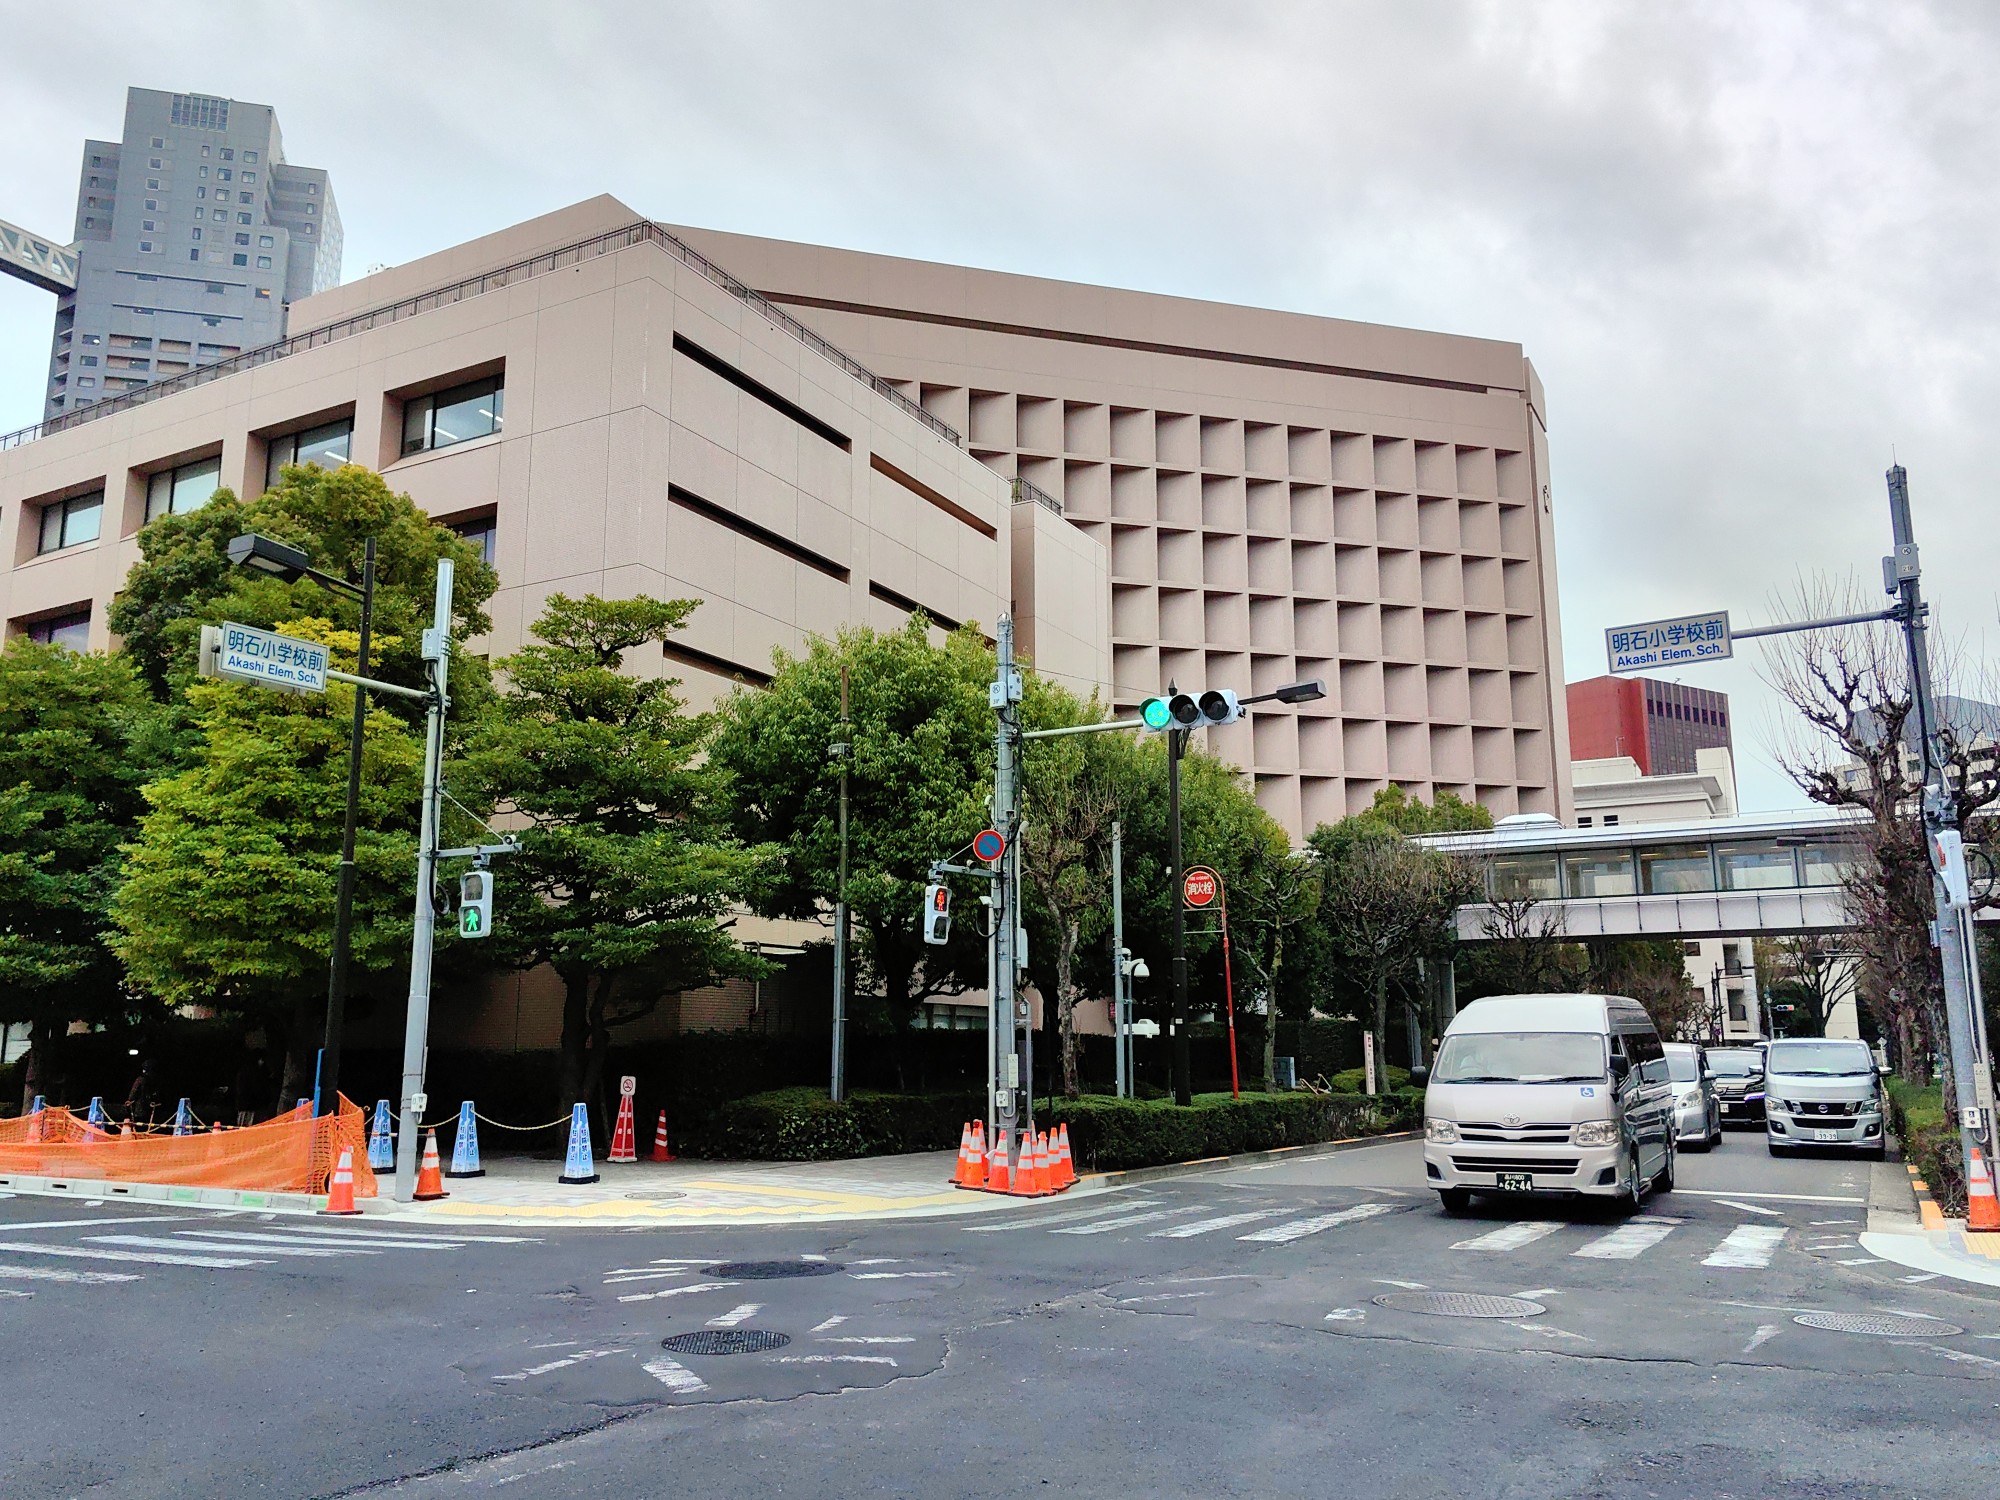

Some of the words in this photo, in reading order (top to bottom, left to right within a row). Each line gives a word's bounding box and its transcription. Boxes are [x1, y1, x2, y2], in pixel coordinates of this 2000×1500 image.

[1612, 619, 1724, 653] 明石小学校前
[228, 630, 324, 671] 明石小学校前
[1617, 652, 1657, 667] Akashi
[1662, 648, 1695, 661] Elem.
[1697, 643, 1723, 656] Sch.
[228, 655, 264, 672] Akashi
[268, 663, 296, 681] Elem.
[298, 670, 319, 685] Sch.
[1187, 881, 1213, 895] 消火栓
[1504, 1180, 1532, 1191] 62-44
